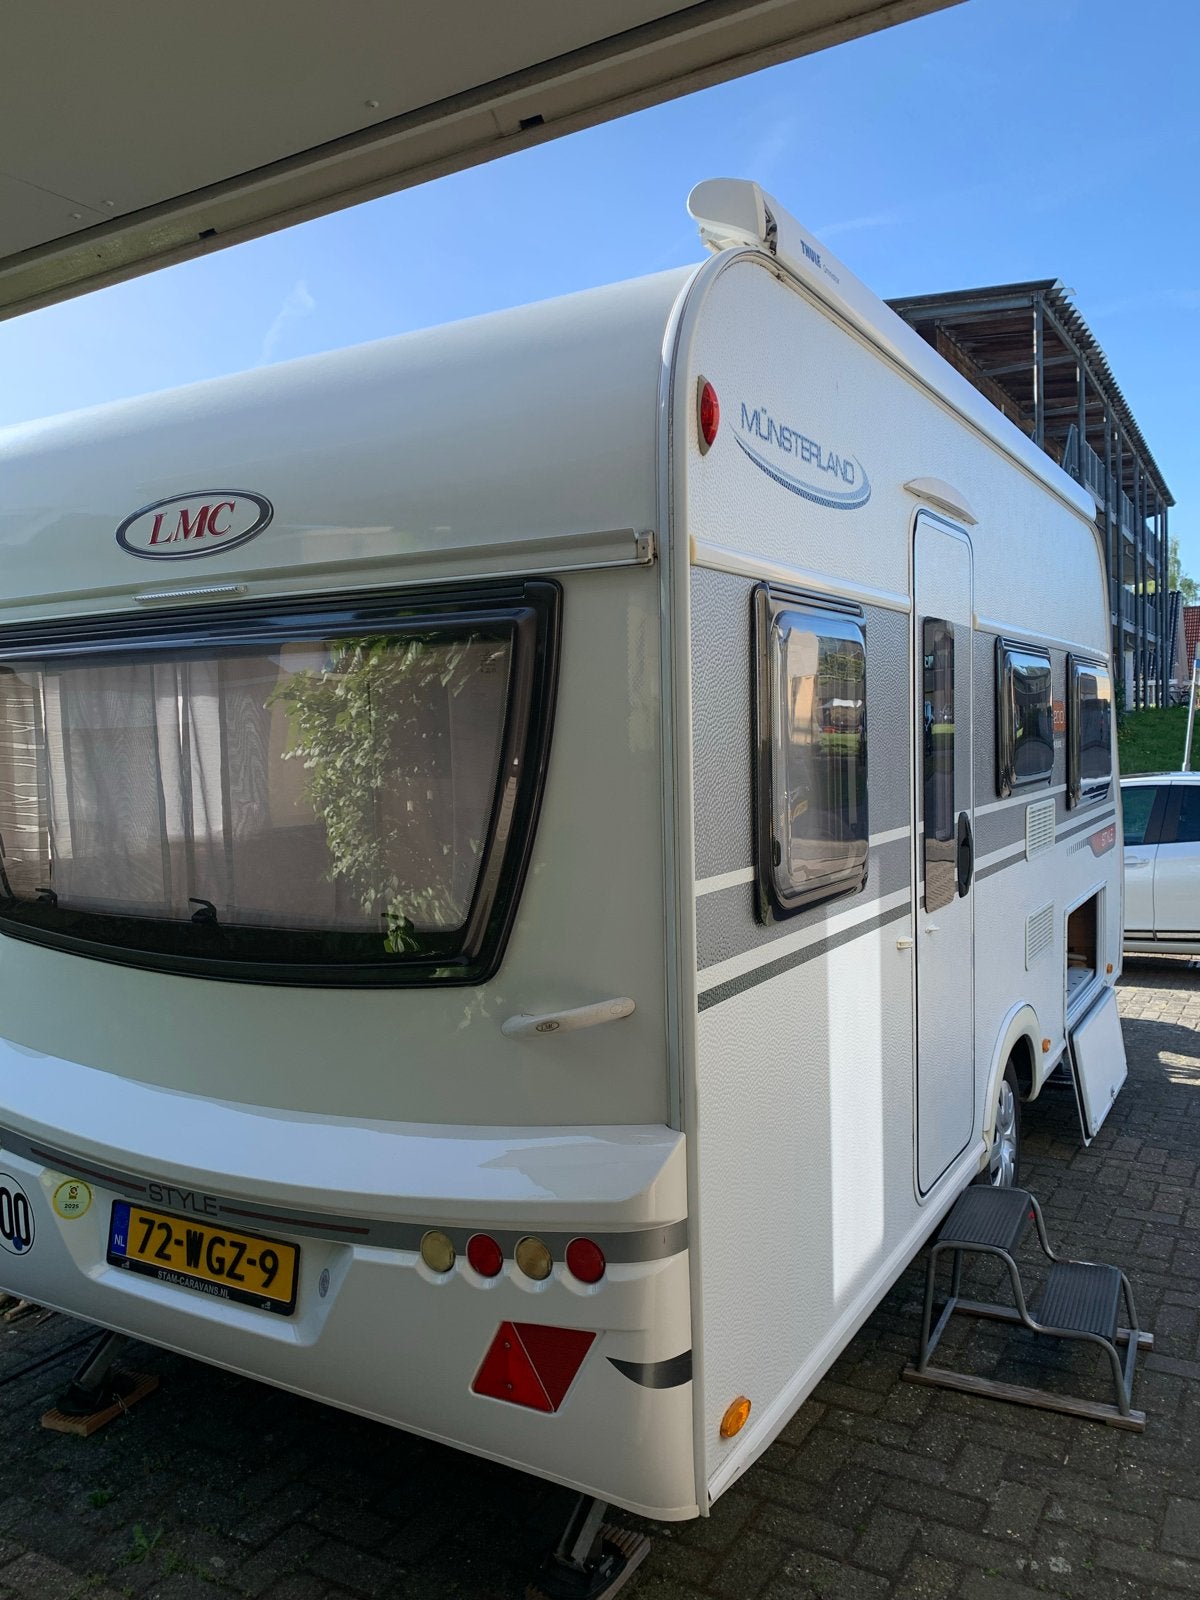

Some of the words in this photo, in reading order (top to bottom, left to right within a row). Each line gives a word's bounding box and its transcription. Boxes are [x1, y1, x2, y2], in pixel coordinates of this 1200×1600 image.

[800, 239, 821, 269] THULE
[741, 402, 855, 485] MÜNSTERLAND
[148, 501, 236, 545] LMC
[148, 1183, 218, 1216] STYLE
[114, 1233, 126, 1247] NL
[137, 1216, 279, 1289] 72-WGZ-9
[157, 1270, 231, 1300] STAM-CARAVANS.NL
